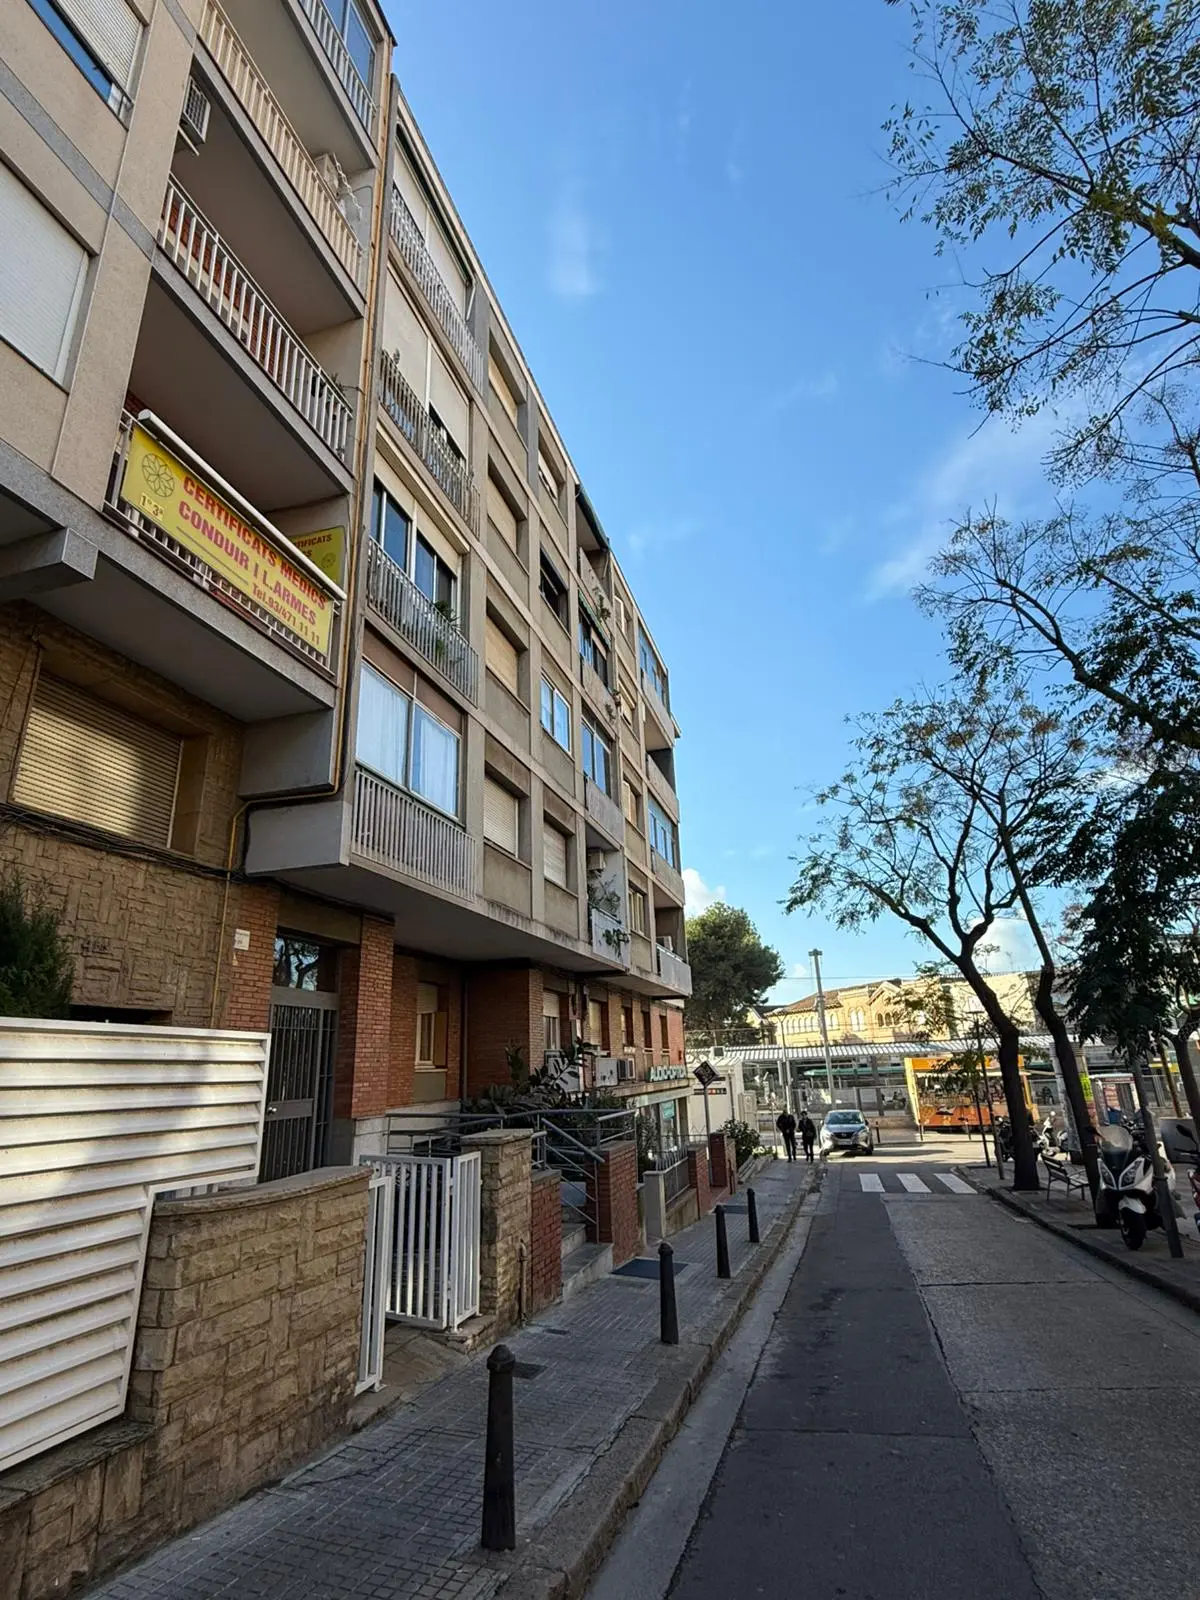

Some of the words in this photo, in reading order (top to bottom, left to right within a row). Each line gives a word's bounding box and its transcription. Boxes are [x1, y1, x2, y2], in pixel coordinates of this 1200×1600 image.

[179, 500, 249, 570] CONDUIR
[253, 562, 259, 579] I
[183, 475, 277, 567] CERTIFICATS
[280, 559, 328, 610] MEDICS
